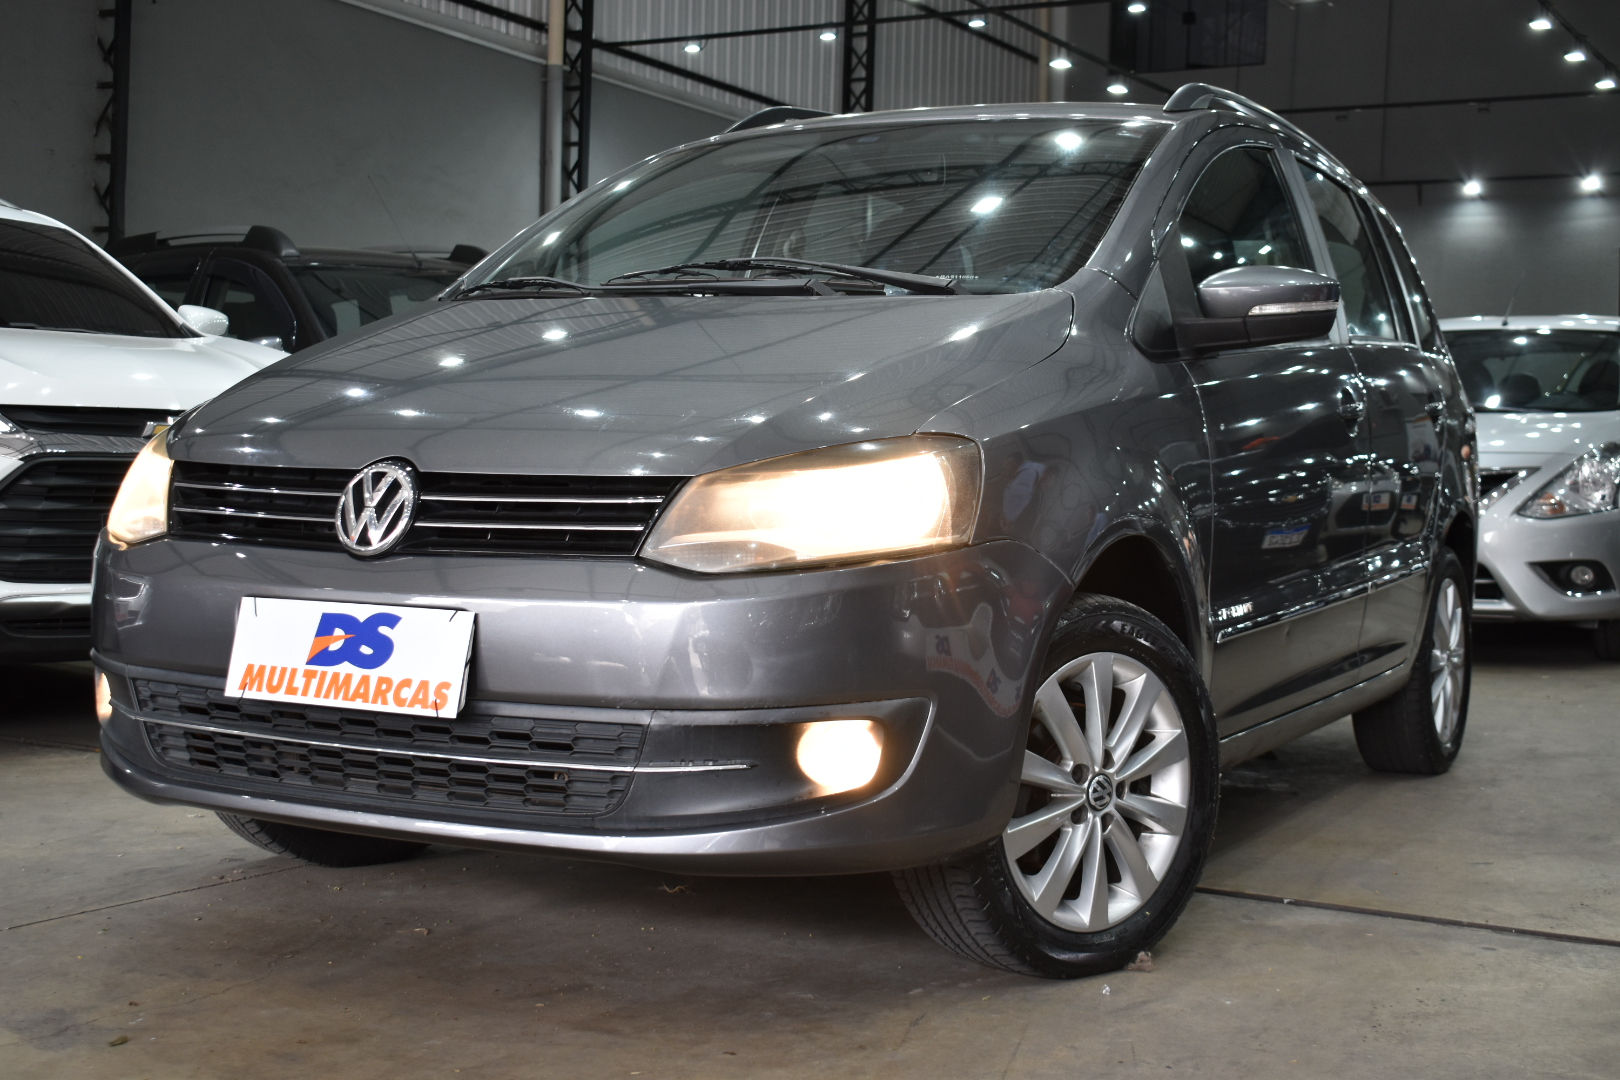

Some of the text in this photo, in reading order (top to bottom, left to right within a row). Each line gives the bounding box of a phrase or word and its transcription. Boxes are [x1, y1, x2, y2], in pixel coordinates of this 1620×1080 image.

[341, 467, 410, 549] VW
[305, 612, 402, 670] DS
[238, 663, 452, 711] MULTIMARCAS
